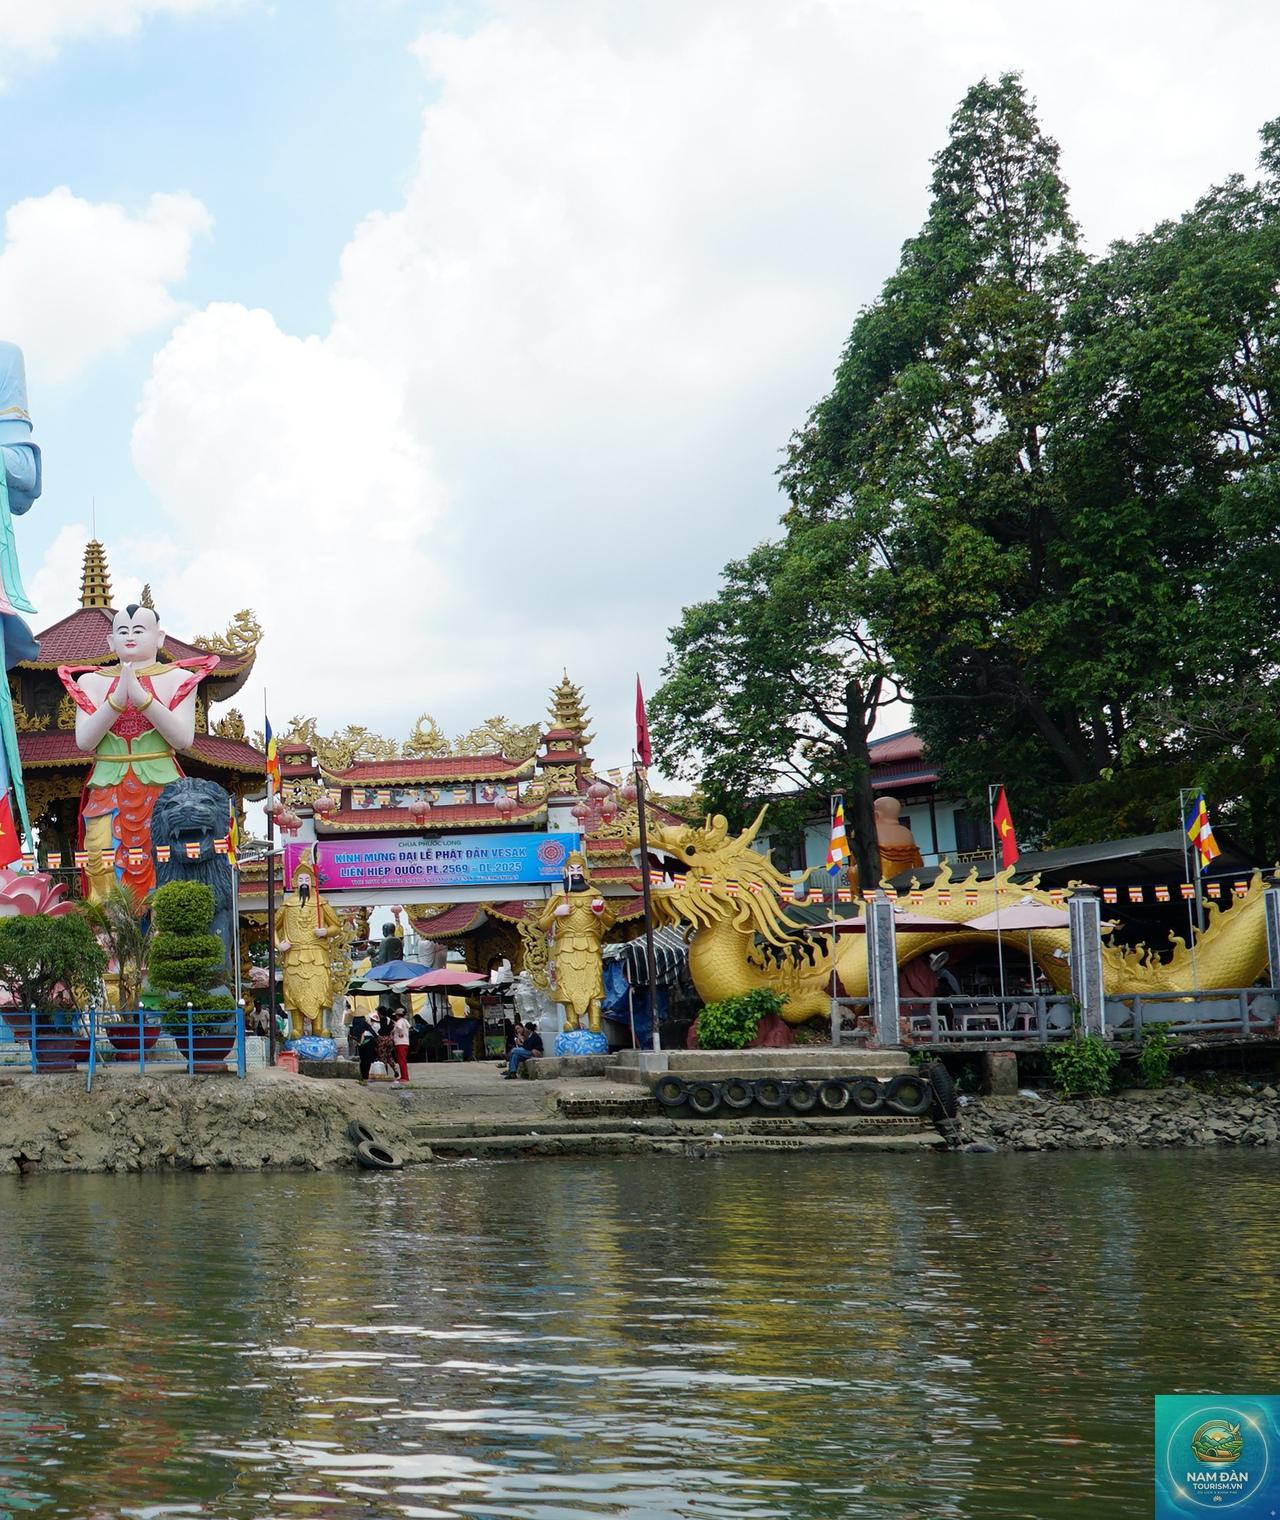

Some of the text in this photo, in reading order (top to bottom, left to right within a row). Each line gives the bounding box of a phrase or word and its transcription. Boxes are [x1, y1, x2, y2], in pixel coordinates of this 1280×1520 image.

[491, 847, 527, 859] VESAK
[426, 864, 468, 875] PL.2569
[479, 862, 523, 873] DL.2025
